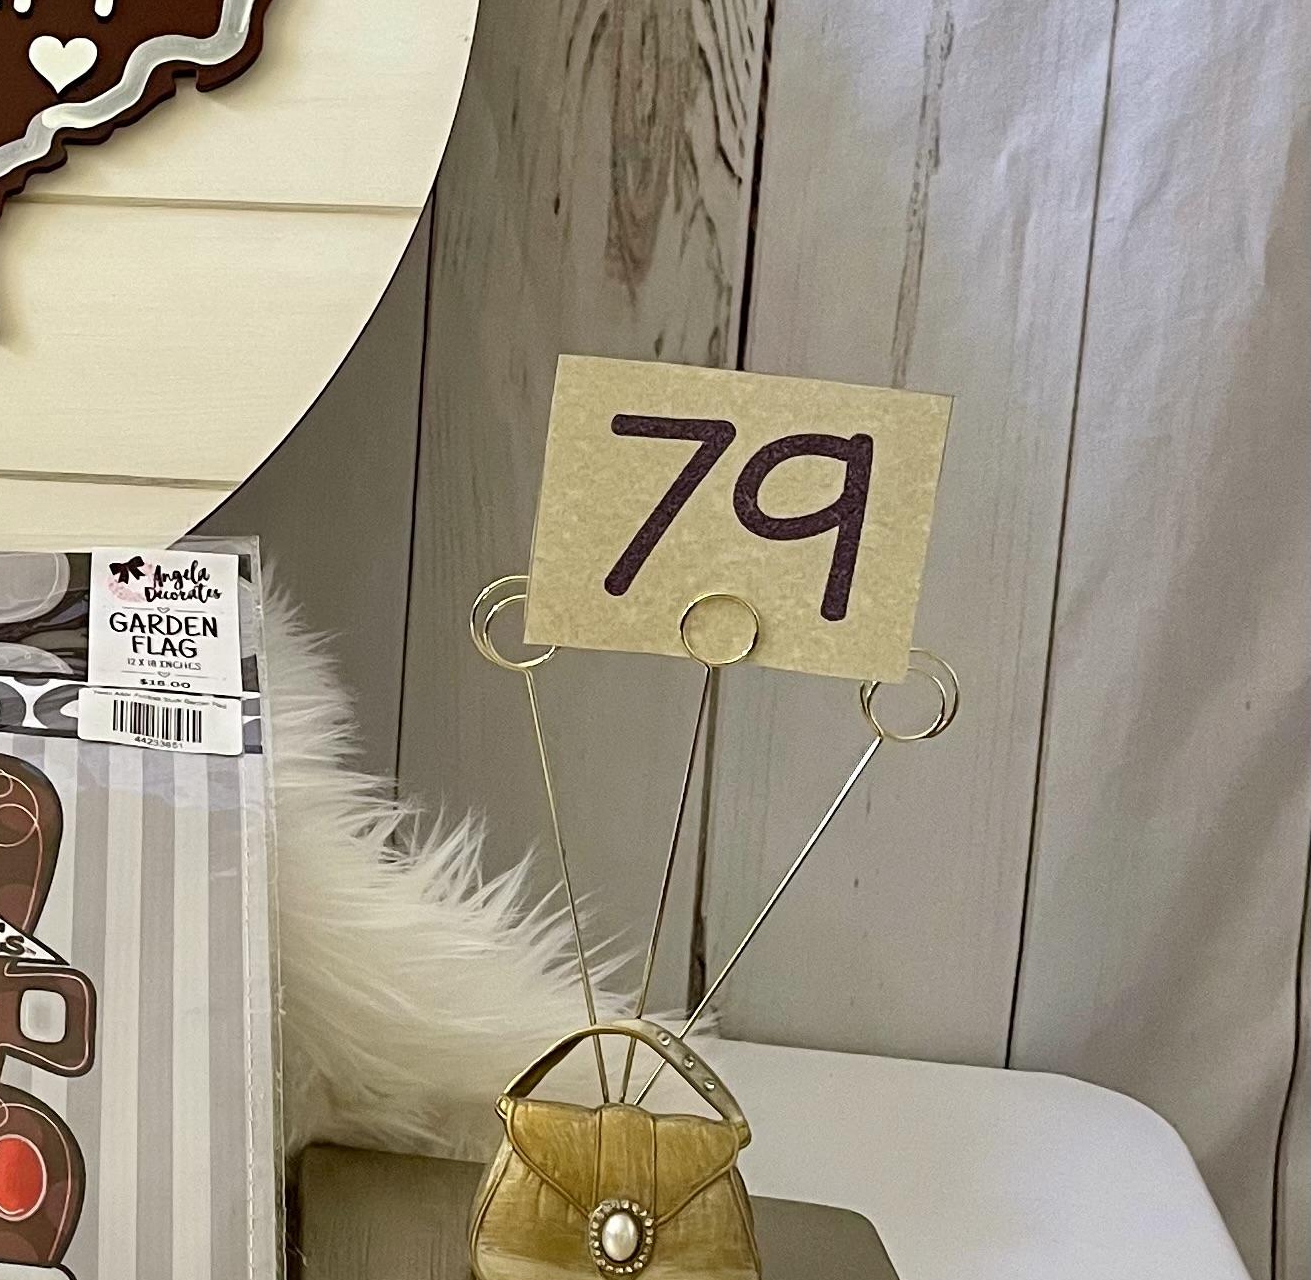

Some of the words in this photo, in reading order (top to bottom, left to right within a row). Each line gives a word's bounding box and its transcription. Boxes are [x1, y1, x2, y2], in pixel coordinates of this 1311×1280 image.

[604, 414, 874, 621] 79
[153, 559, 211, 591] Angela
[144, 583, 222, 604] Decorates
[109, 611, 219, 638] GARDEN
[131, 635, 198, 659] FLAG
[140, 678, 191, 689] $18.00
